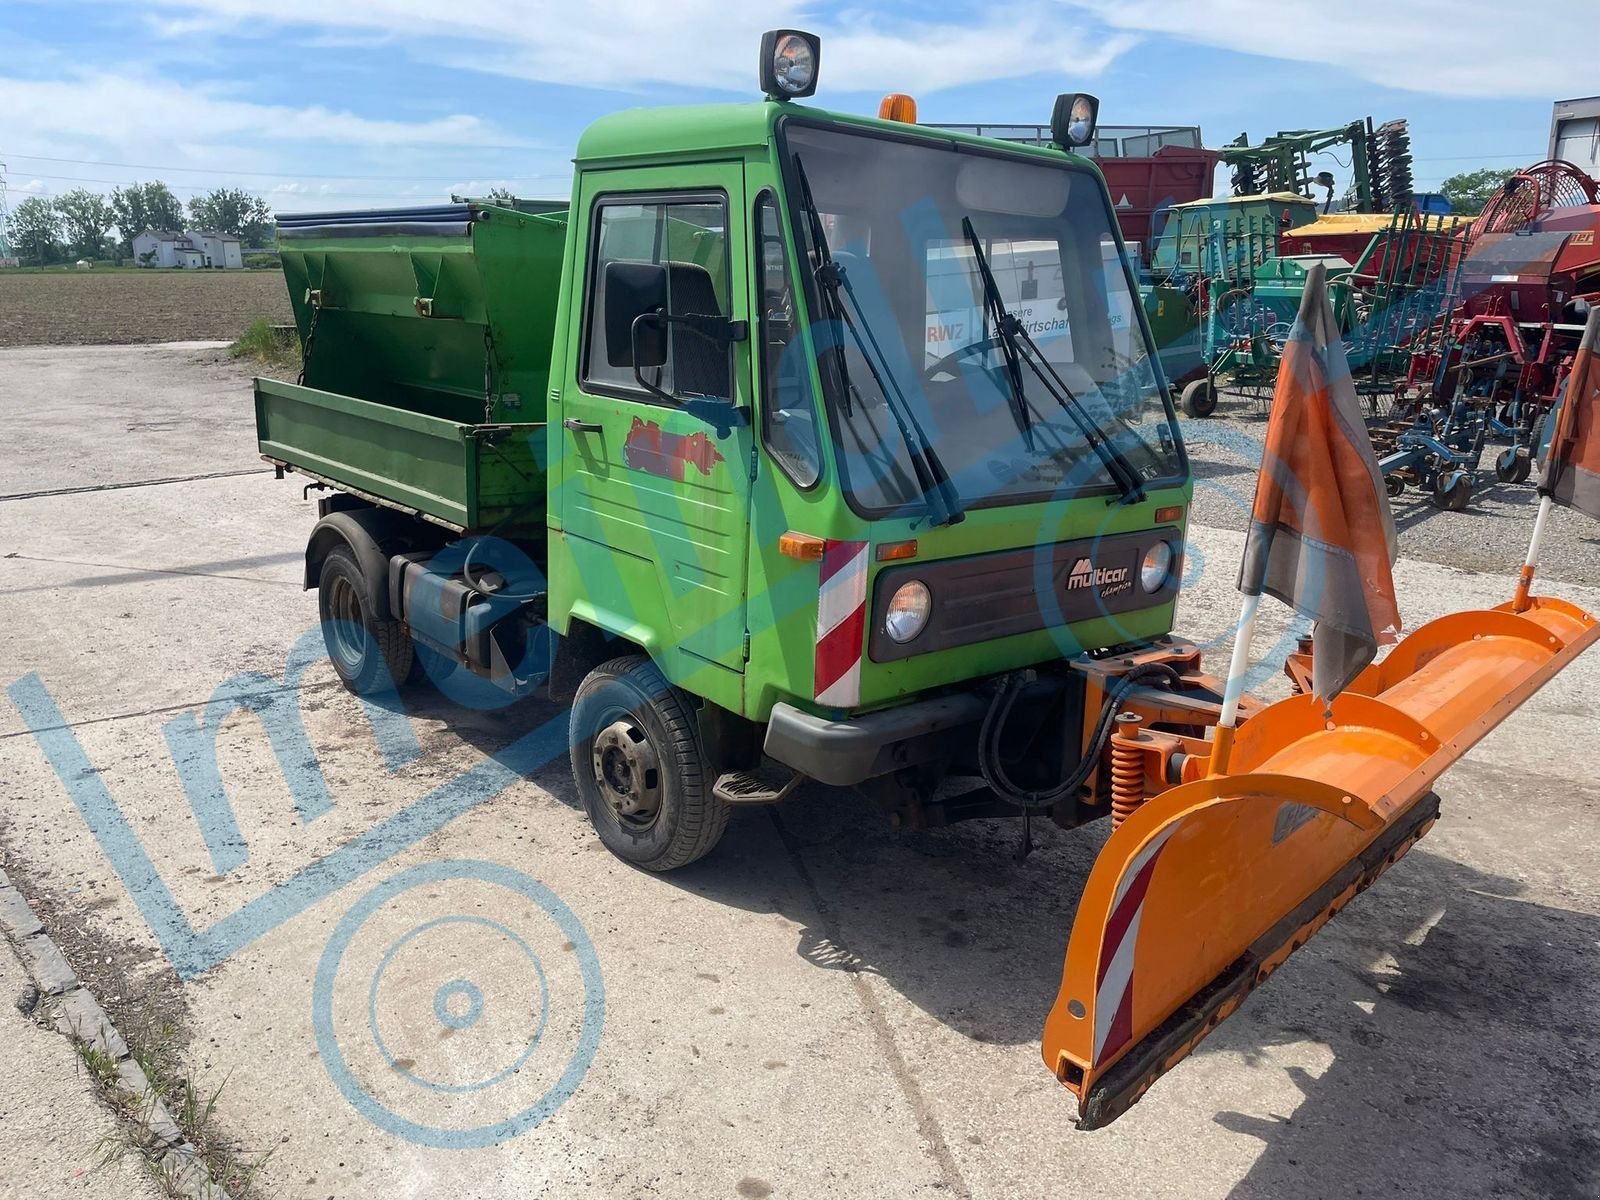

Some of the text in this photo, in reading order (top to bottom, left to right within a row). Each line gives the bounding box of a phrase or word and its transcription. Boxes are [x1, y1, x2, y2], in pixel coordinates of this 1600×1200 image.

[1005, 307, 1033, 318] nsere
[927, 323, 964, 343] RWZ
[1101, 581, 1132, 598] champion
